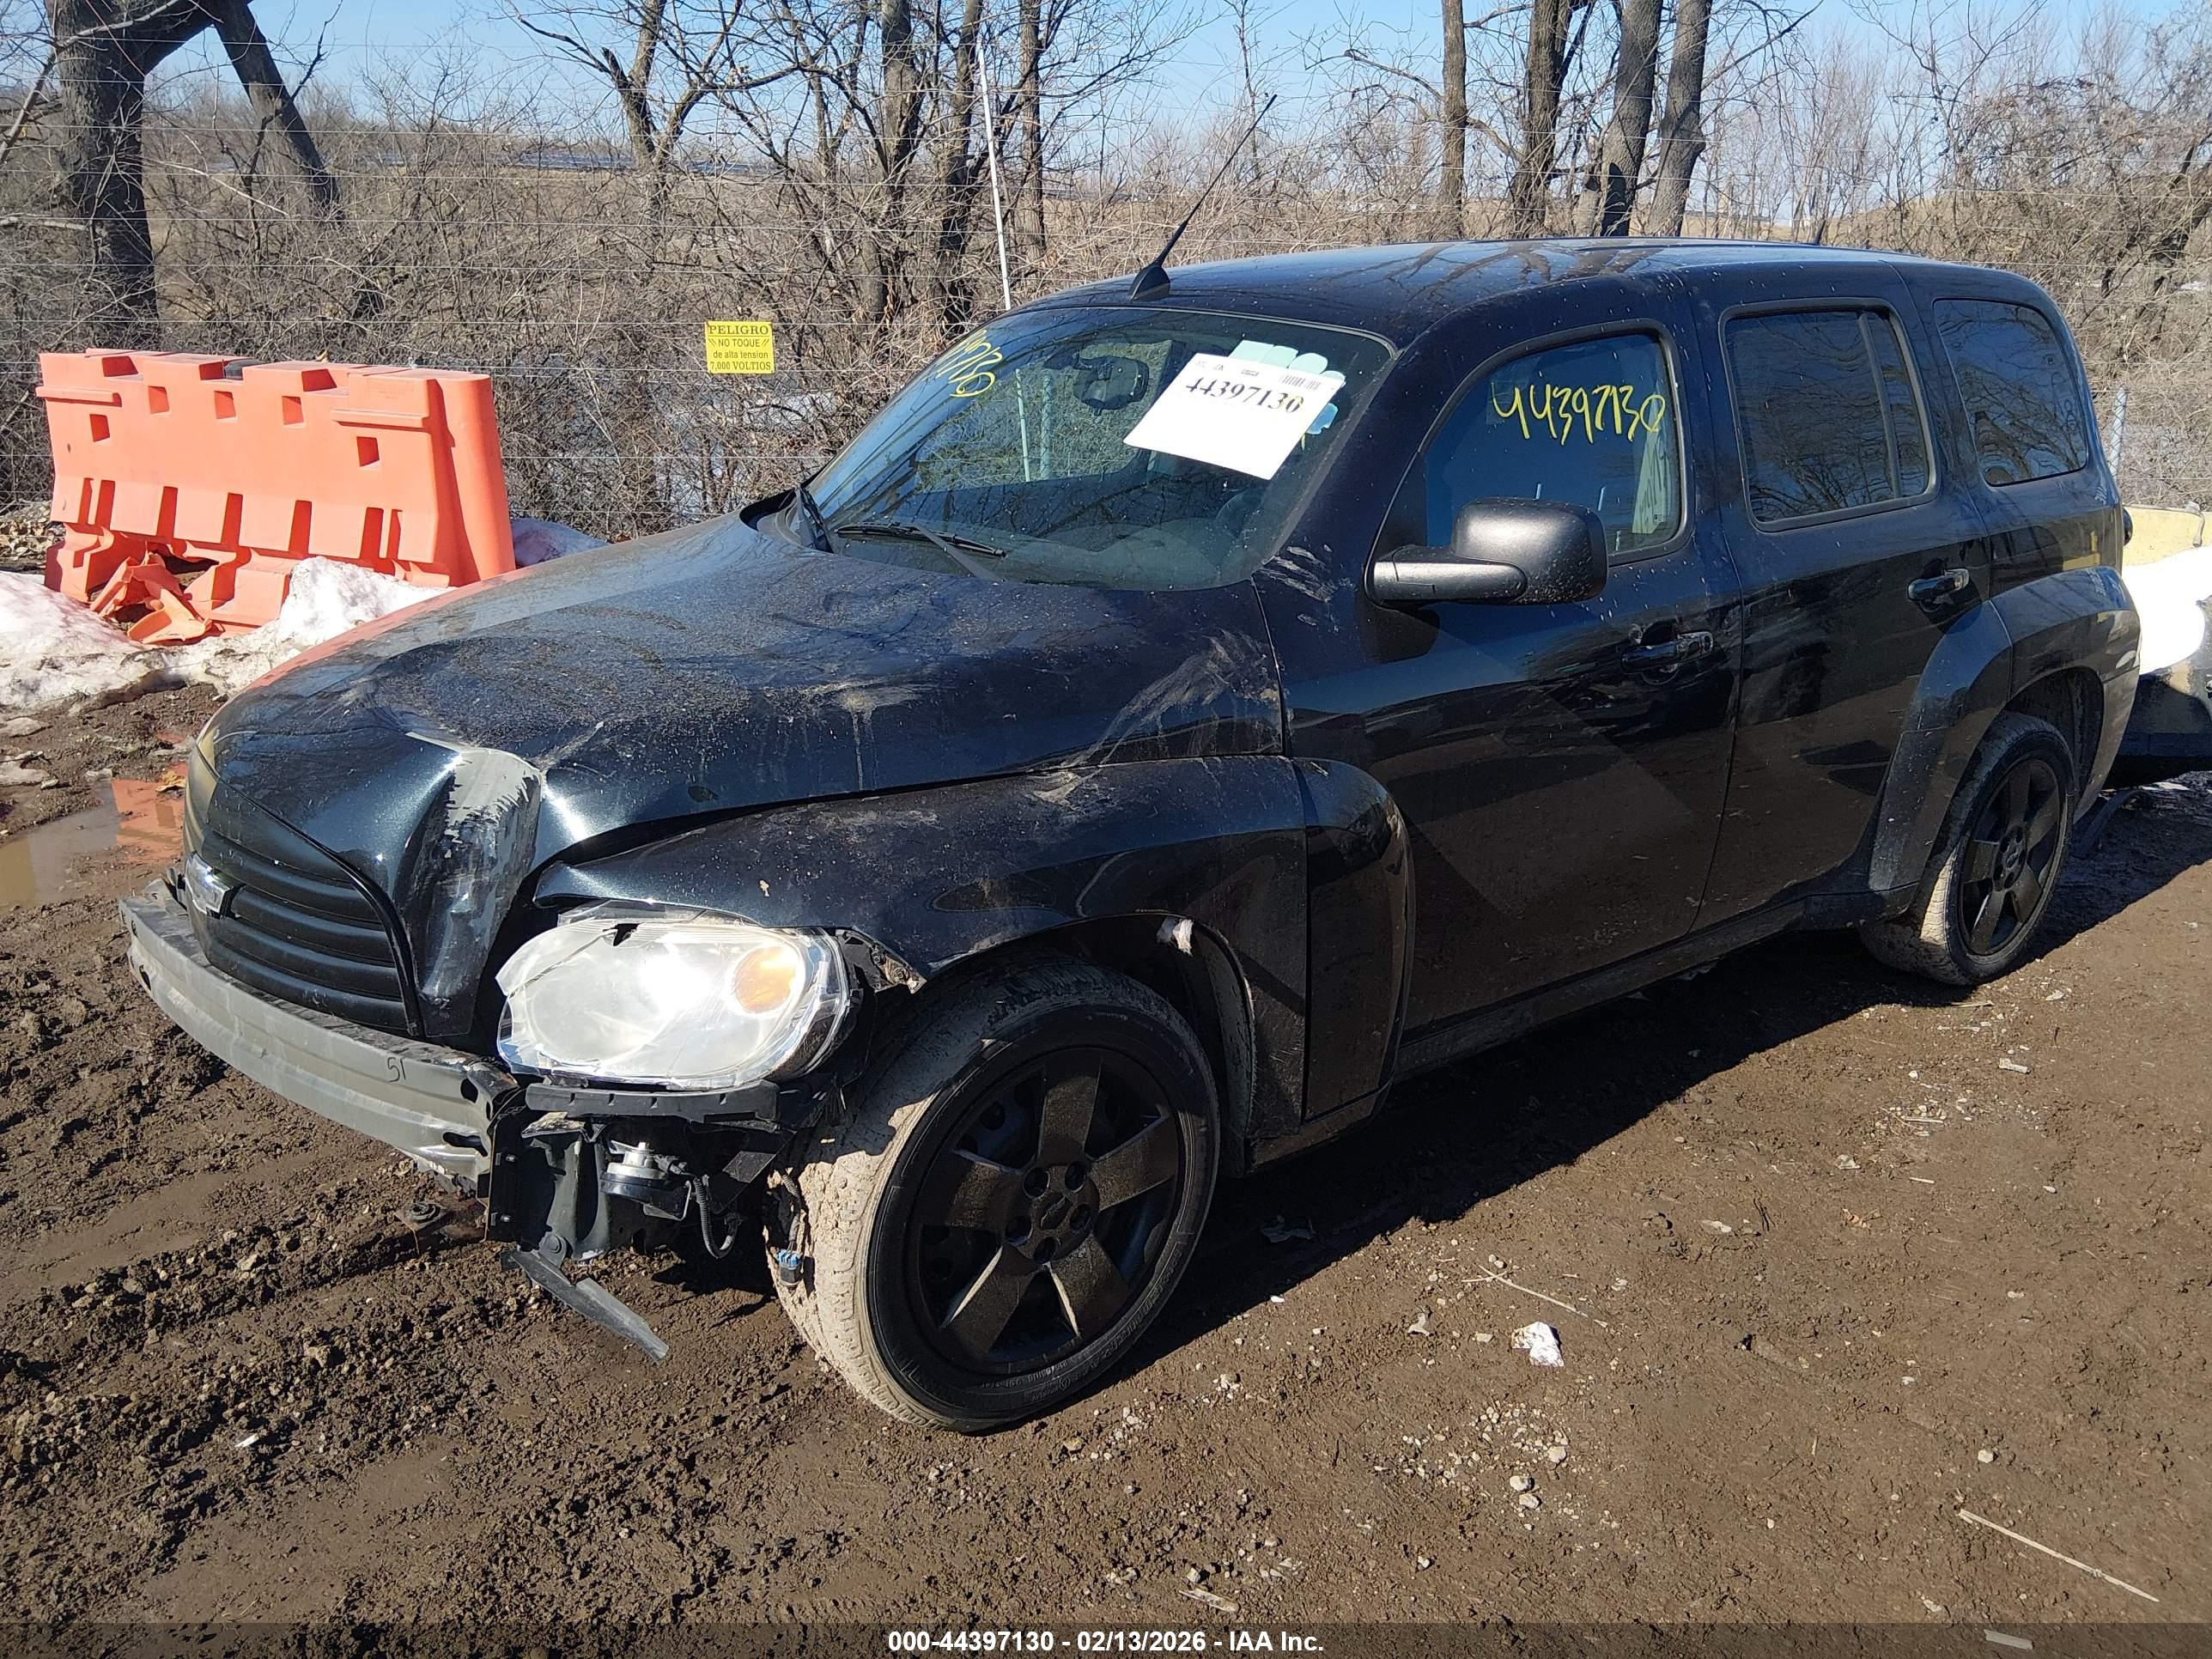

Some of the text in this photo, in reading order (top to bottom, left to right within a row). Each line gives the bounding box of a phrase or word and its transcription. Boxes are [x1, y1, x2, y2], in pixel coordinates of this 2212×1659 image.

[708, 325, 769, 335] PELIGRO
[718, 338, 761, 347] NO TOQUE
[713, 350, 769, 359] de alta tension
[710, 361, 771, 372] 7,000 VOLTIOS
[1185, 376, 1304, 414] 44397130
[1491, 382, 1666, 446] 44397130
